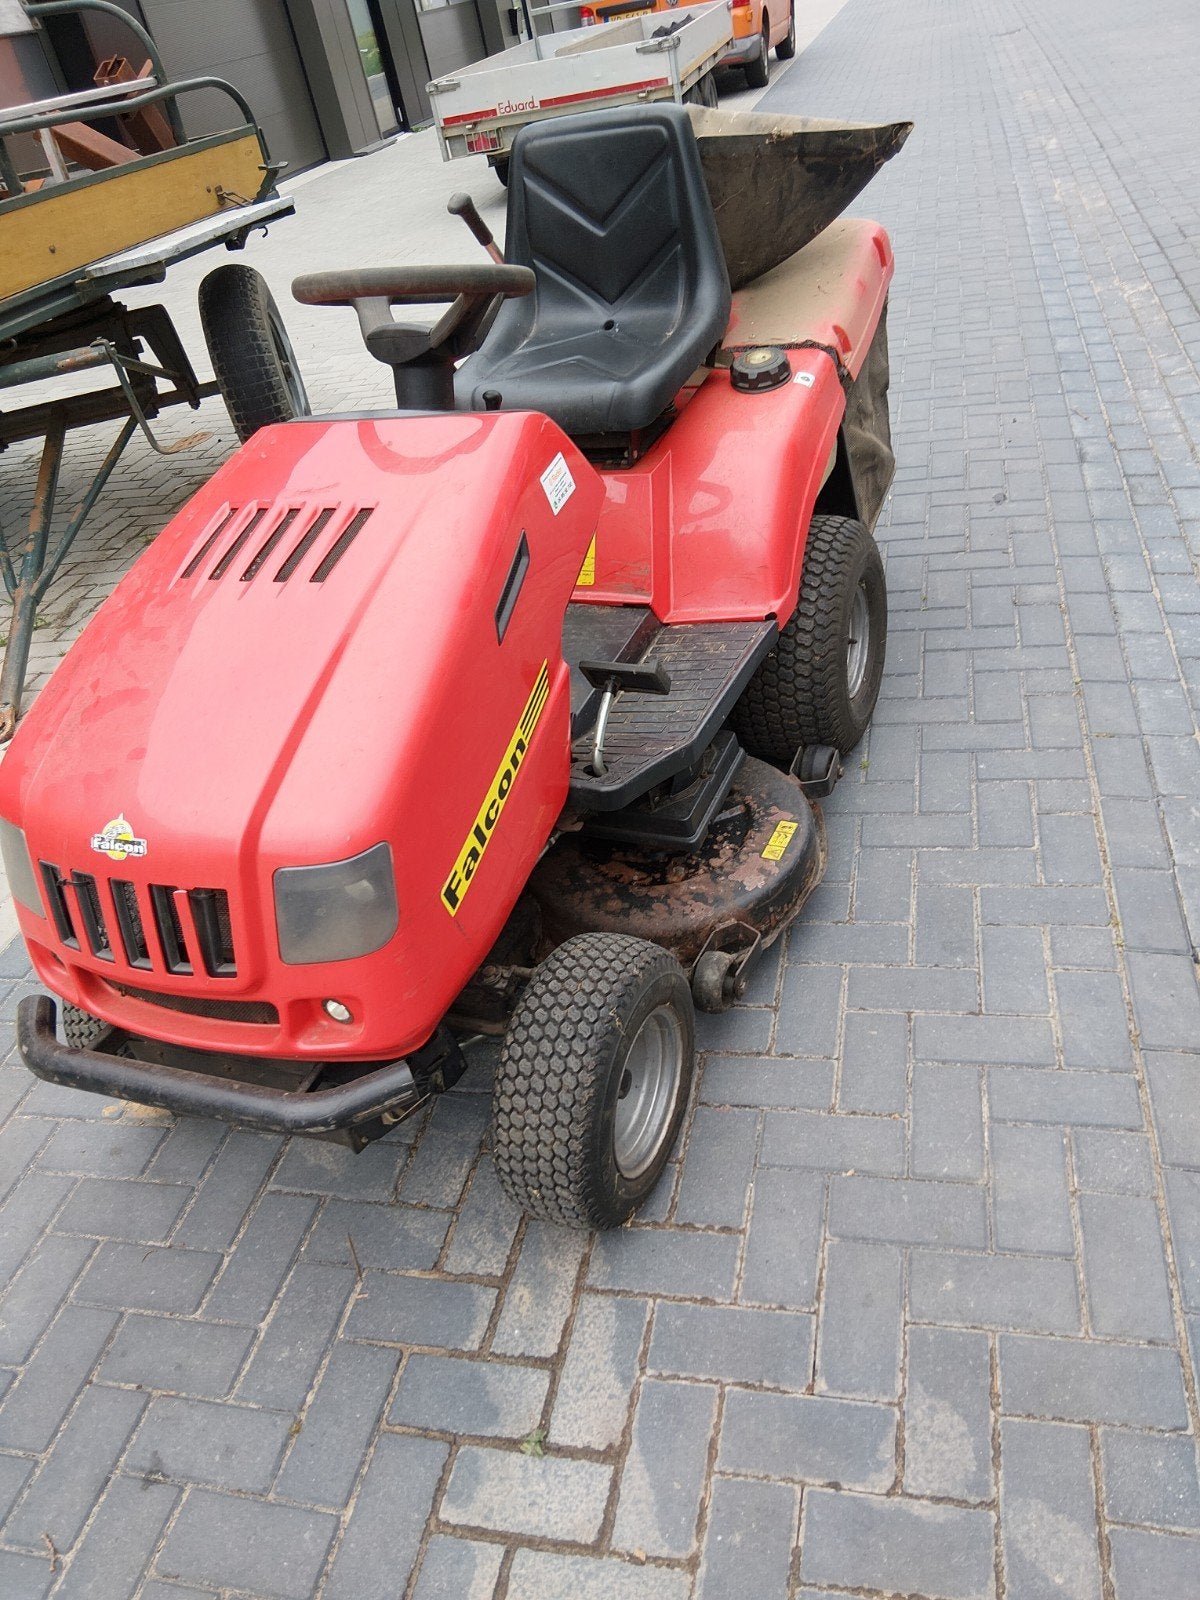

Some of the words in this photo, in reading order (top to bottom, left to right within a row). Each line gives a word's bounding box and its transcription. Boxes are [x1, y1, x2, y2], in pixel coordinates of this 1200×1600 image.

[498, 96, 538, 114] Eduard
[443, 737, 527, 910] Falcon
[92, 835, 145, 855] Falcon
